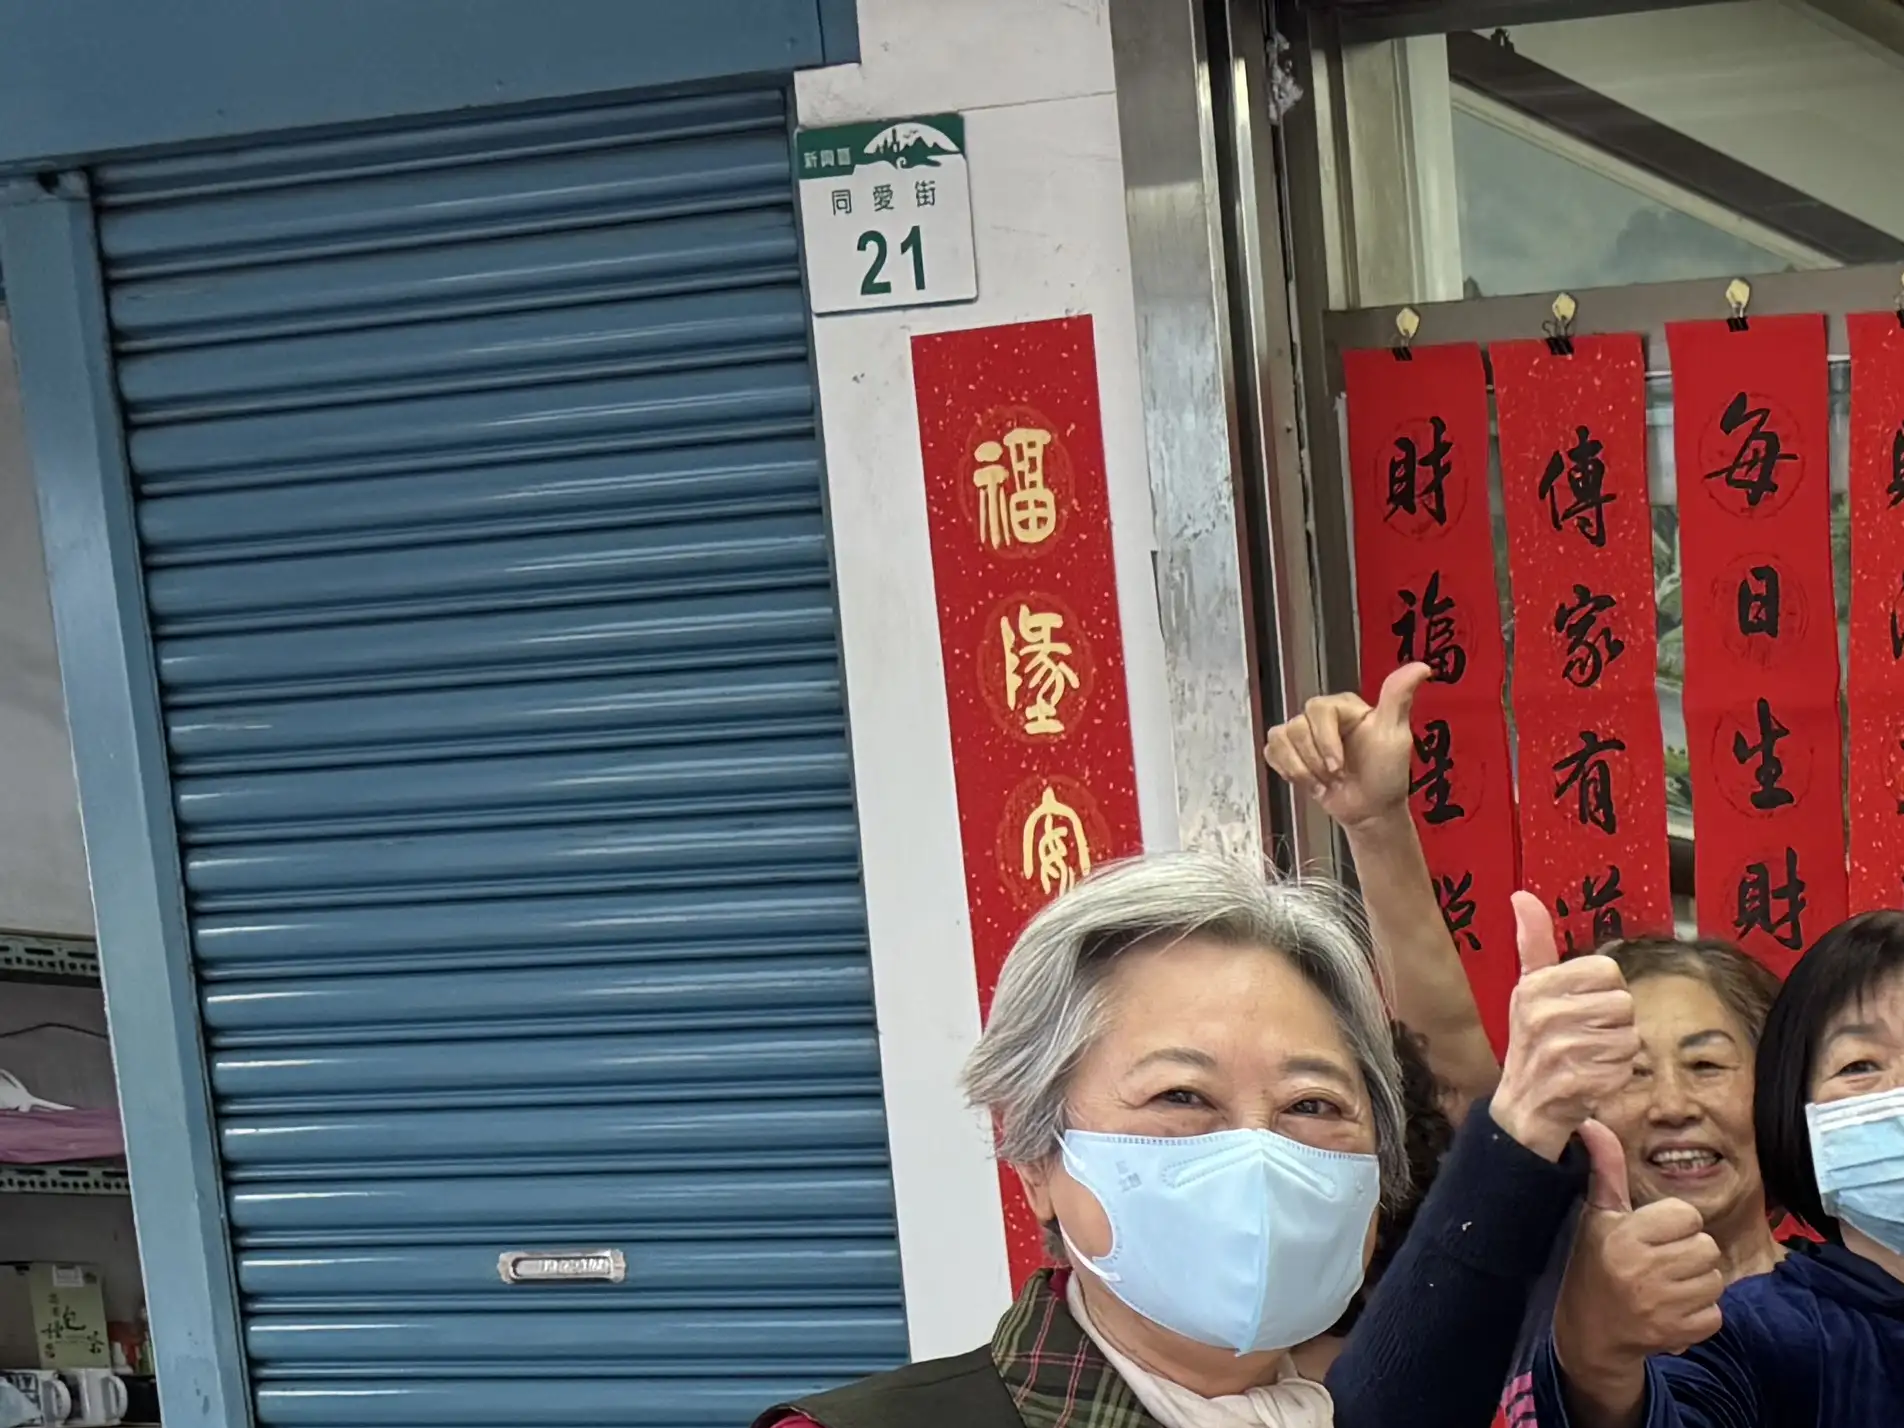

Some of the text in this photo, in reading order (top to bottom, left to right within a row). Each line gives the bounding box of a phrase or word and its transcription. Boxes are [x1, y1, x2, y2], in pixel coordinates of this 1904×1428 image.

[831, 181, 936, 215] 同愛街
[857, 225, 926, 295] 21
[1704, 391, 1806, 950] 每日生財
